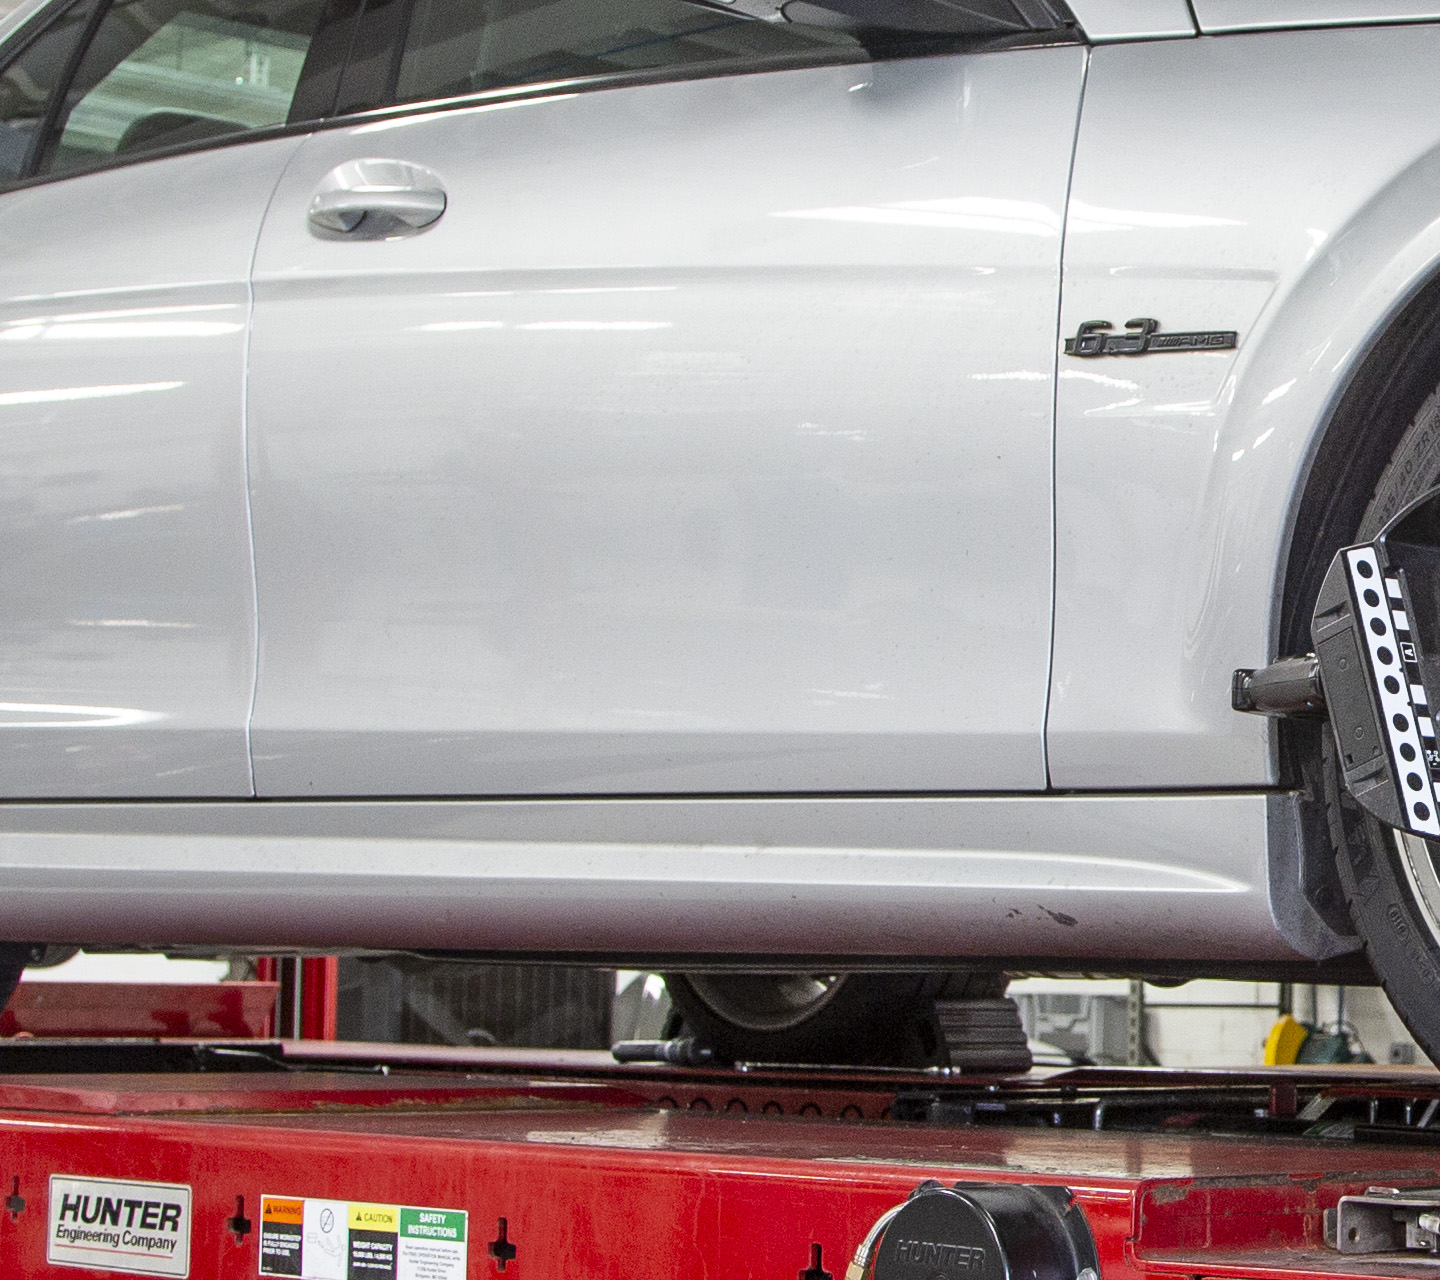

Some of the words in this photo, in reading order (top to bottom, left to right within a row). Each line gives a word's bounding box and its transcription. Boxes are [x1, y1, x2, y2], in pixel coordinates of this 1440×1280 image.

[59, 1193, 182, 1232] HUNTER
[273, 1205, 301, 1216] WARNING
[364, 1213, 393, 1224] CAUTION
[419, 1212, 447, 1224] SAFETY
[407, 1225, 457, 1238] INSTRUCTIONS
[56, 1224, 120, 1248] Engineering
[122, 1230, 177, 1253] Company
[895, 1239, 986, 1269] HUNTER
